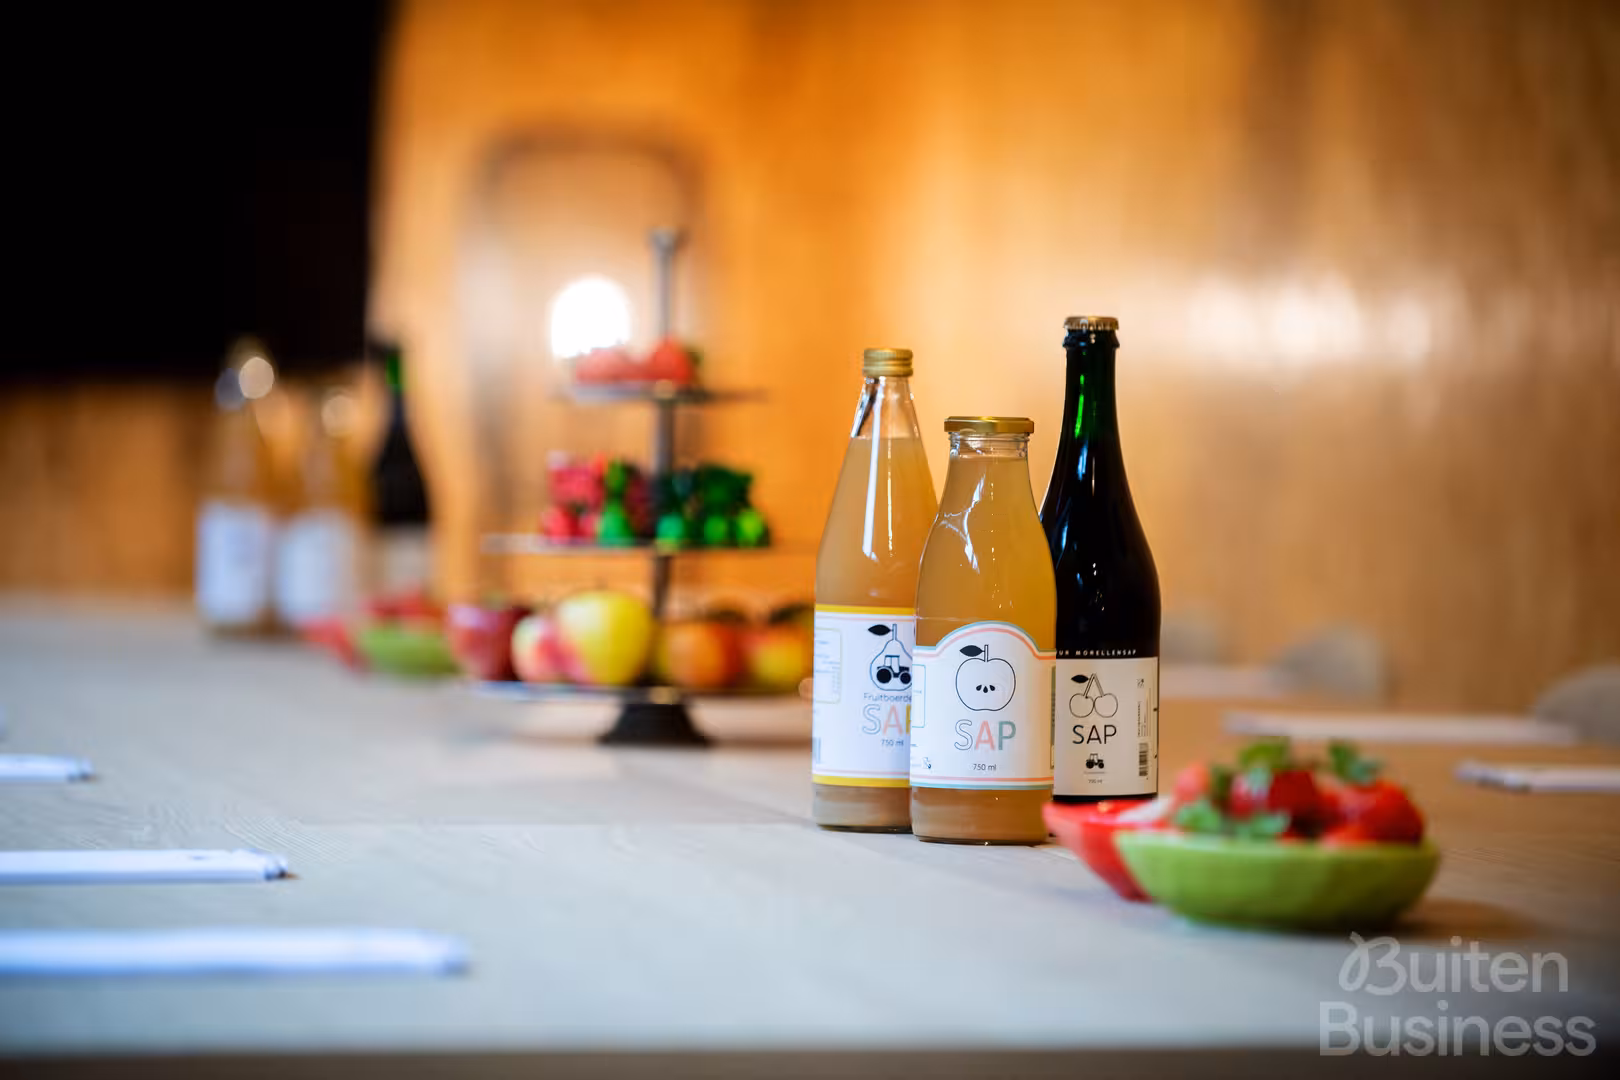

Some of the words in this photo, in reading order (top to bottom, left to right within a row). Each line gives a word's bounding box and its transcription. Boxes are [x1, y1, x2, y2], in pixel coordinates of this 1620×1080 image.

[954, 719, 1017, 750] SAP
[1072, 724, 1117, 745] SAP
[972, 763, 987, 771] 750
[988, 763, 998, 771] ml
